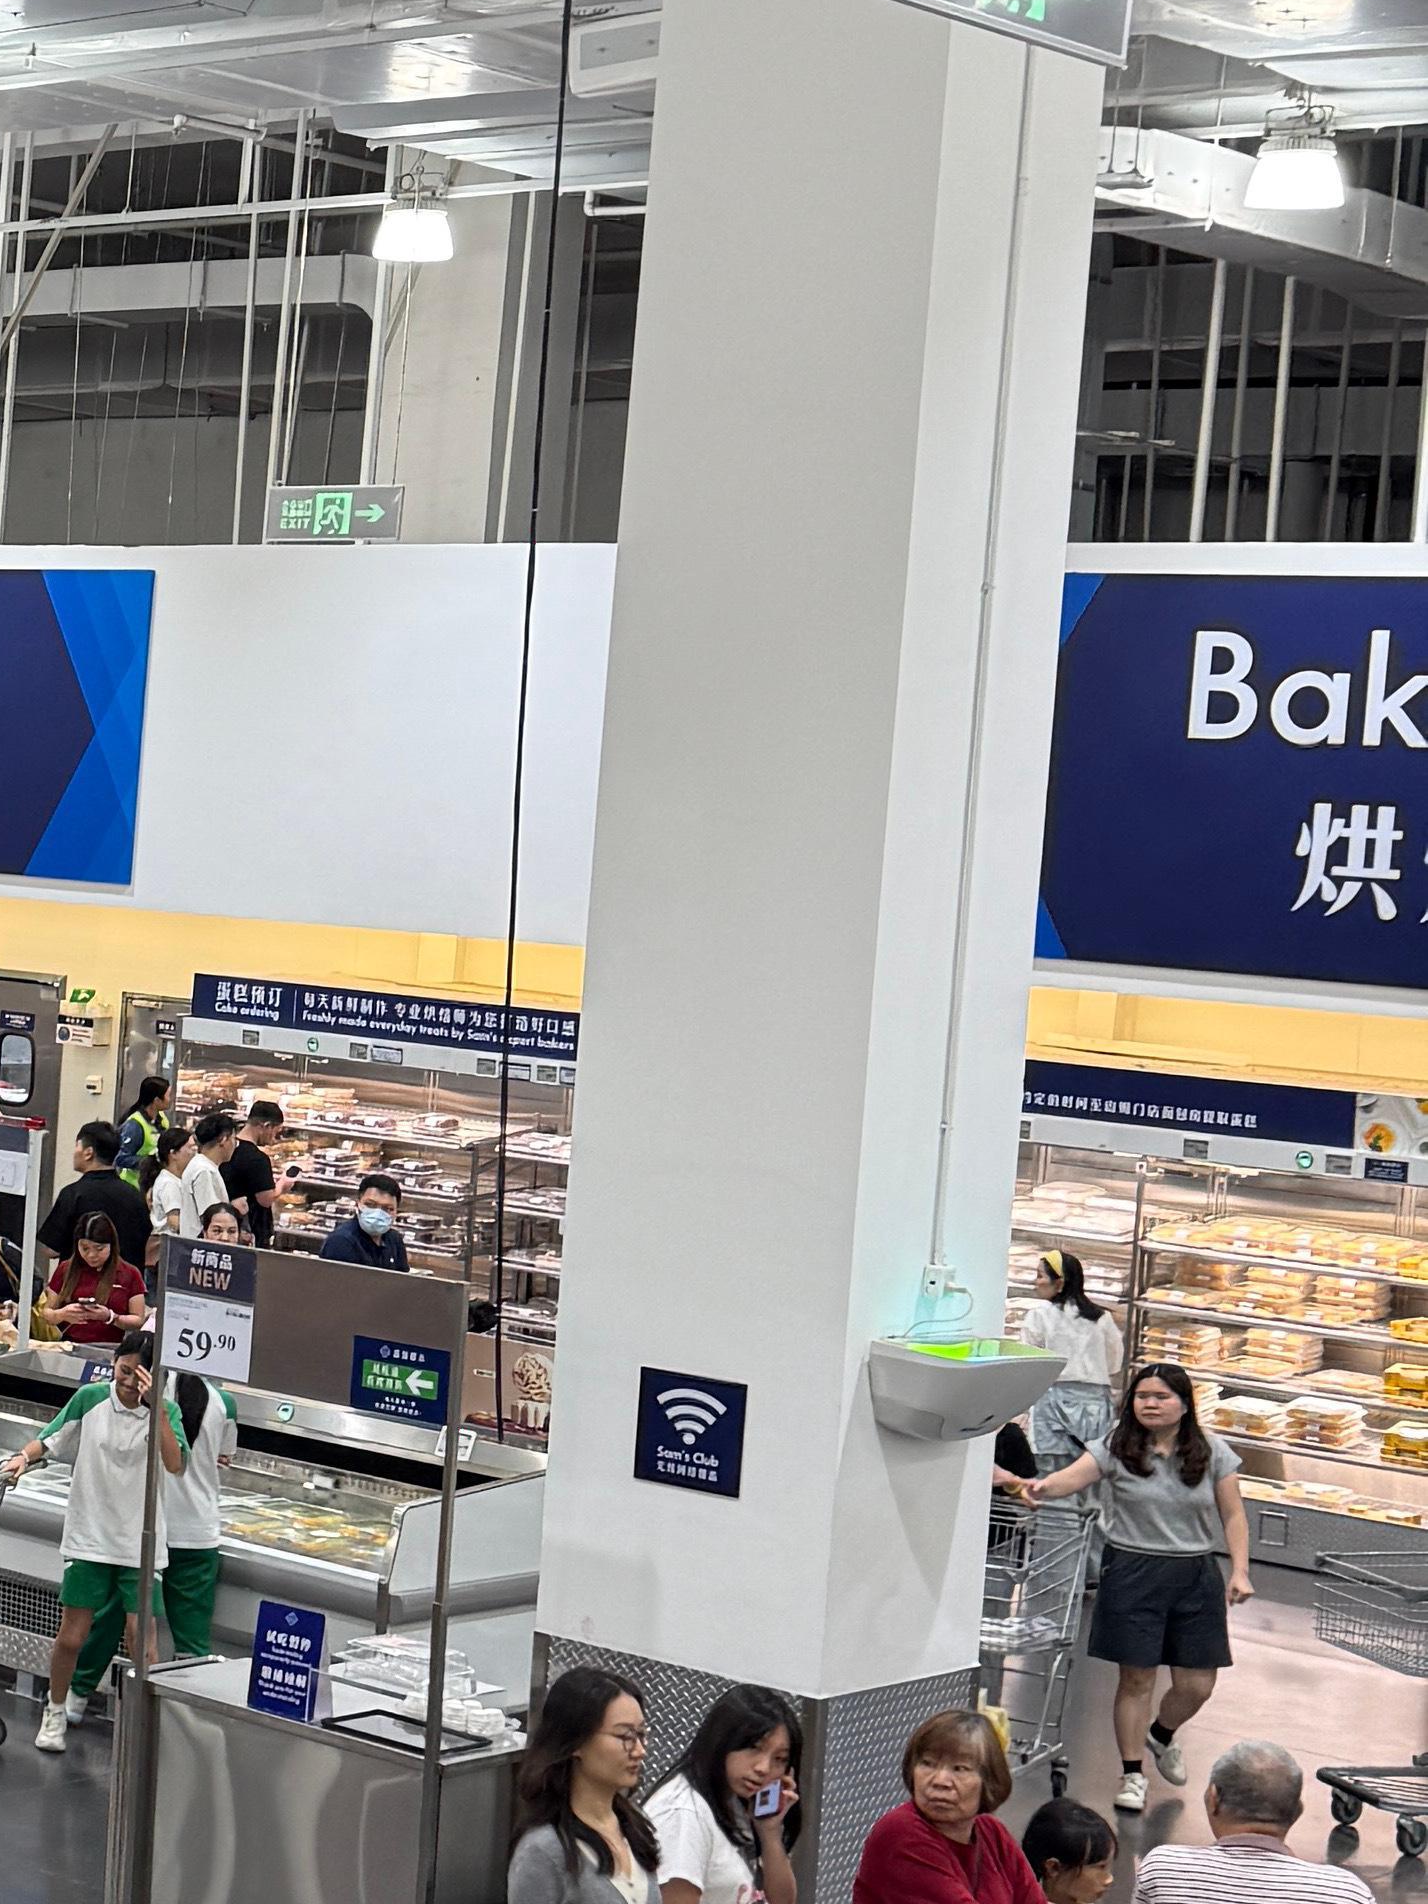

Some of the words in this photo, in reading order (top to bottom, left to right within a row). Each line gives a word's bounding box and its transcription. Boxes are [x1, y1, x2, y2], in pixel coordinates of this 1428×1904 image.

[279, 517, 311, 530] EXIT
[1288, 801, 1428, 924] 烘
[215, 981, 283, 1008] 蛋糕预订
[214, 1001, 238, 1015] Cake
[240, 1006, 280, 1022] ordering
[302, 1009, 336, 1026] Freshly
[338, 1014, 367, 1028] made
[369, 1018, 417, 1036] everyday
[419, 1024, 449, 1038] treats
[451, 1026, 465, 1041] by
[467, 1029, 498, 1043] Sam's
[499, 1034, 535, 1048] epert
[537, 1035, 575, 1051] bakers
[191, 1248, 233, 1271] 新商品
[189, 1266, 232, 1291] NEW
[176, 1327, 236, 1361] 59.90
[656, 1445, 690, 1463] Sam's
[692, 1452, 719, 1468] Club
